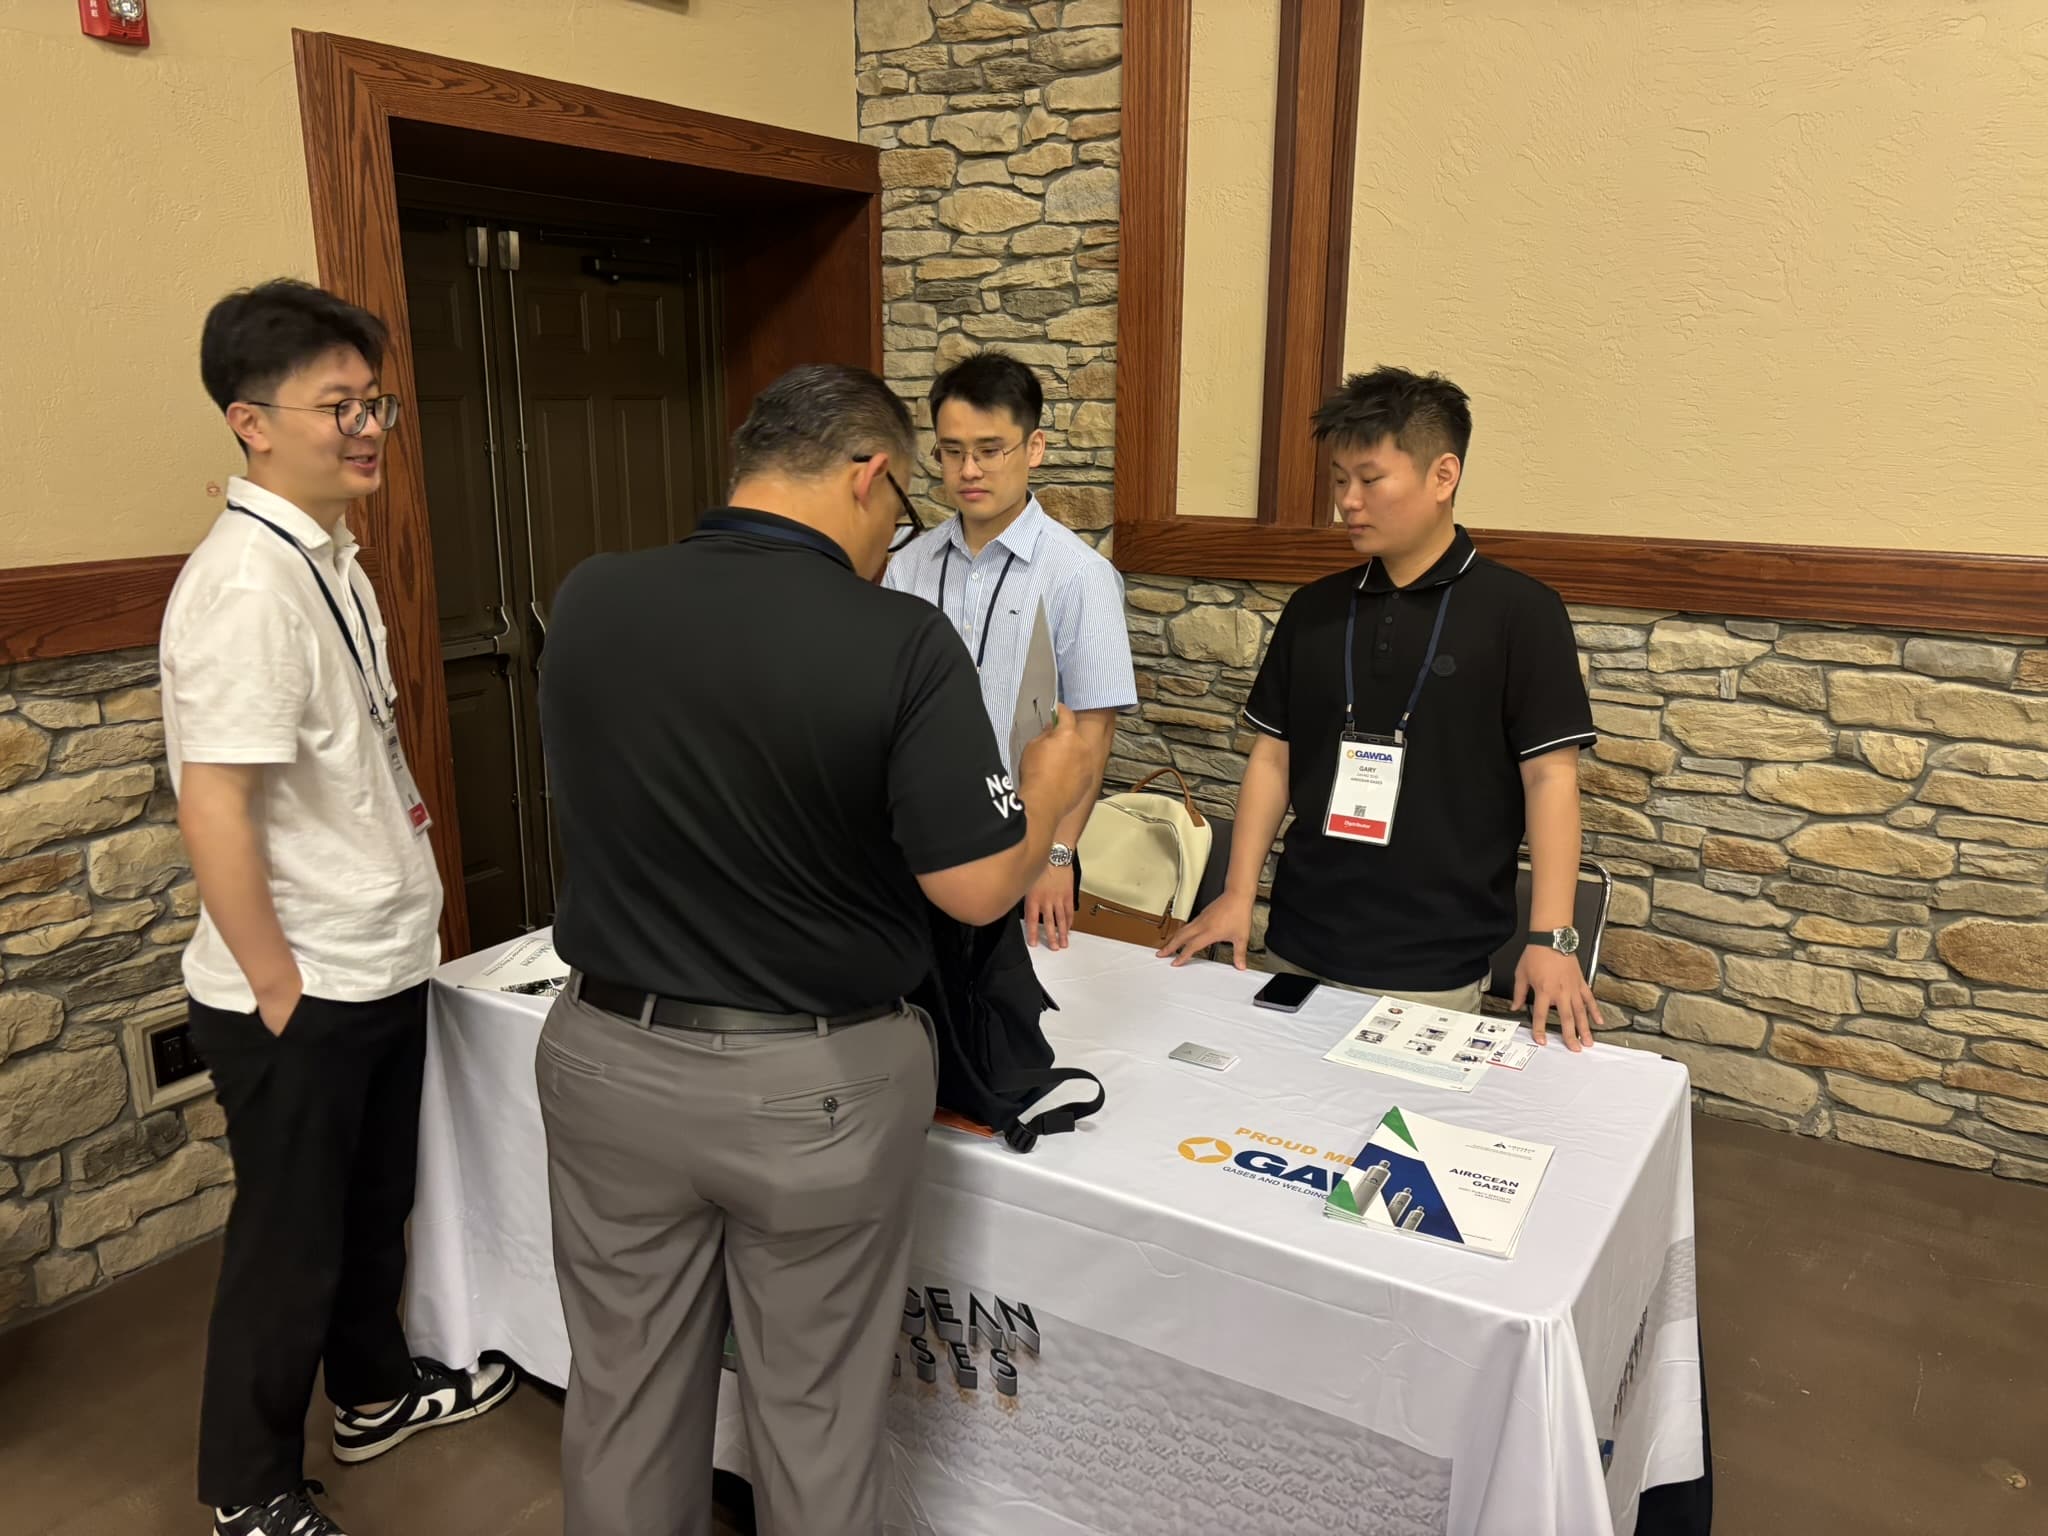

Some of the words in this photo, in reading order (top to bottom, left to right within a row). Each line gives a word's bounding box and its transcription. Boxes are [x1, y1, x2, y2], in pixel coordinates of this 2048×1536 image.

[1355, 750, 1393, 762] GAWDA
[1234, 1127, 1318, 1155] PROUD
[1222, 1166, 1256, 1179] GASES
[1257, 1176, 1280, 1186] AND
[1234, 1150, 1344, 1192] GA
[1449, 1168, 1519, 1188] AIROCEAN
[1472, 1181, 1516, 1195] GASES
[894, 1336, 1017, 1393] SES
